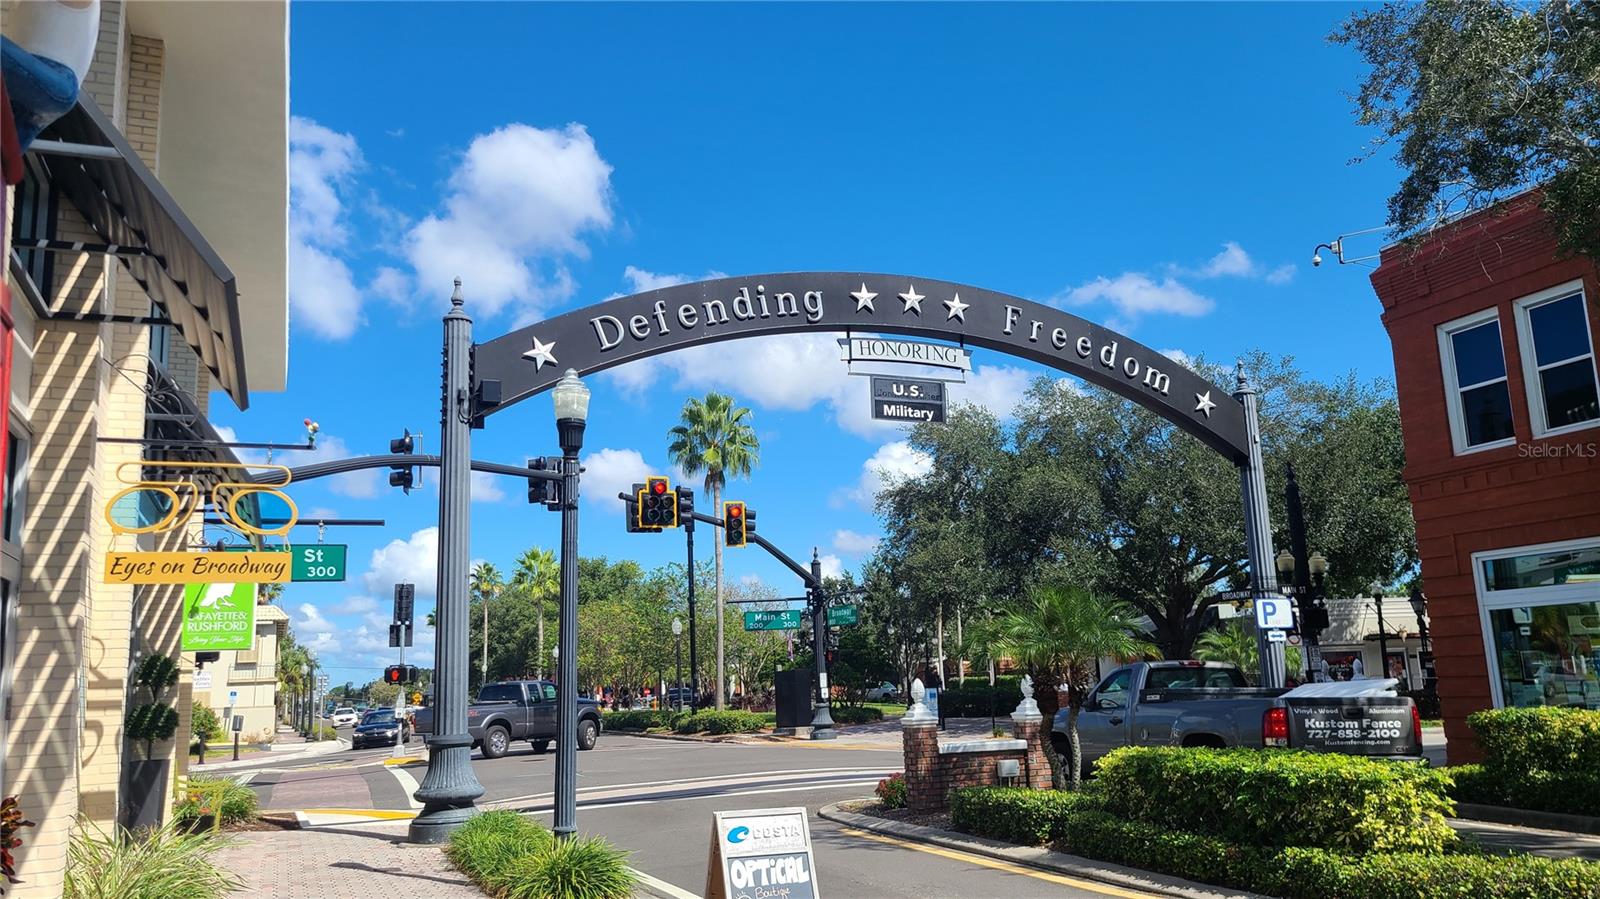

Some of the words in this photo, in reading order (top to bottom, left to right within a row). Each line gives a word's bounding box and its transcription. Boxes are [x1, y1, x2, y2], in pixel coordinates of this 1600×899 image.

[589, 284, 824, 352] Defending
[1003, 304, 1171, 396] Freedom
[859, 341, 958, 363] HONORING
[892, 383, 924, 397] U.S.
[883, 404, 935, 422] Military
[303, 548, 324, 563] St
[110, 556, 155, 581] Eyes
[161, 563, 185, 575] on
[192, 555, 286, 581] Broadway
[306, 566, 337, 577] 300
[1222, 591, 1251, 600] BROADWAY
[1281, 586, 1297, 594] MAIN
[1299, 586, 1306, 594] ST
[754, 613, 776, 622] Main
[780, 612, 790, 620] St
[1262, 601, 1277, 625] P
[188, 621, 248, 632] RUSHFORD
[1304, 718, 1359, 729] Kustom
[1362, 718, 1402, 728] Fence
[1307, 729, 1400, 739] 727-858-2100
